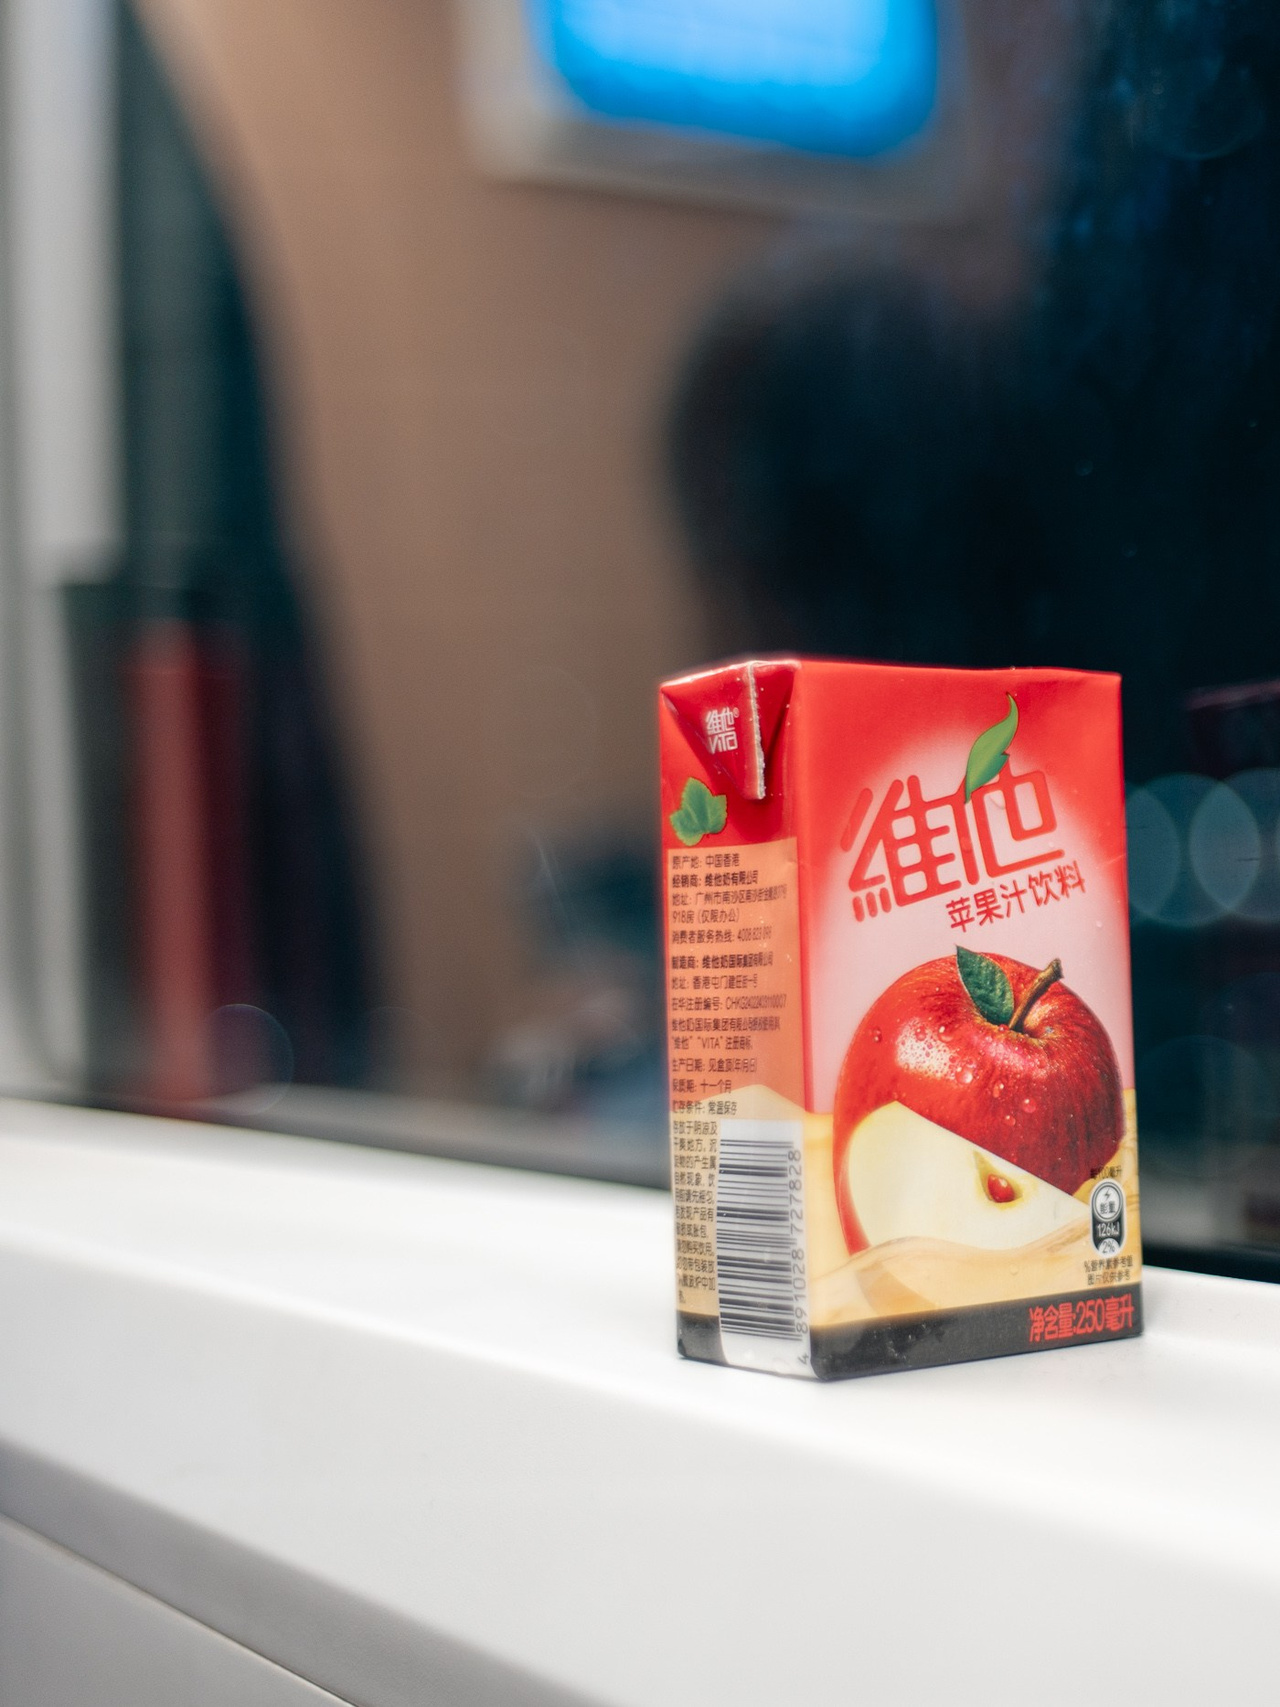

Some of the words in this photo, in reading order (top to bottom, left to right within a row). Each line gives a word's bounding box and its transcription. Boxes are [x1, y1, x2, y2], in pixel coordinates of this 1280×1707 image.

[946, 860, 1086, 932] 苹果汁饮料
[1102, 1240, 1115, 1254] 2%
